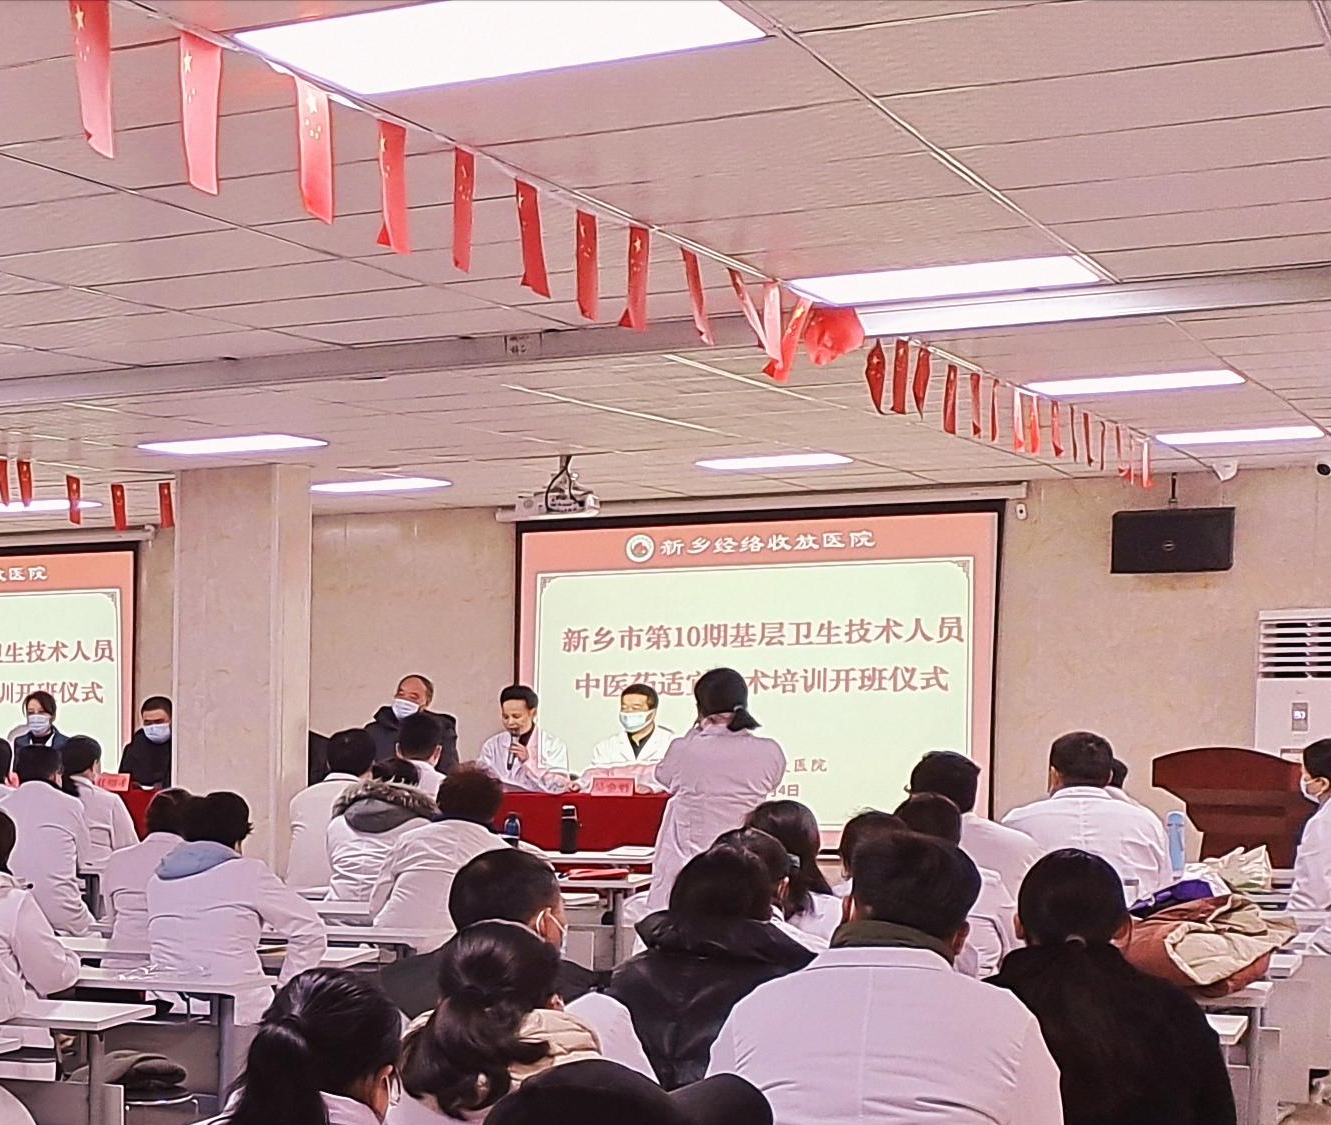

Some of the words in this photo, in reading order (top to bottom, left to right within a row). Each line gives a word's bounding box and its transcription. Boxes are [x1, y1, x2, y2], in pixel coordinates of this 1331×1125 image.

[659, 529, 877, 556] 新乡经络收放医院
[562, 616, 965, 654] 新乡市第10期基层卫生技术人员
[786, 758, 828, 773] 医院
[771, 783, 800, 798] 4日
